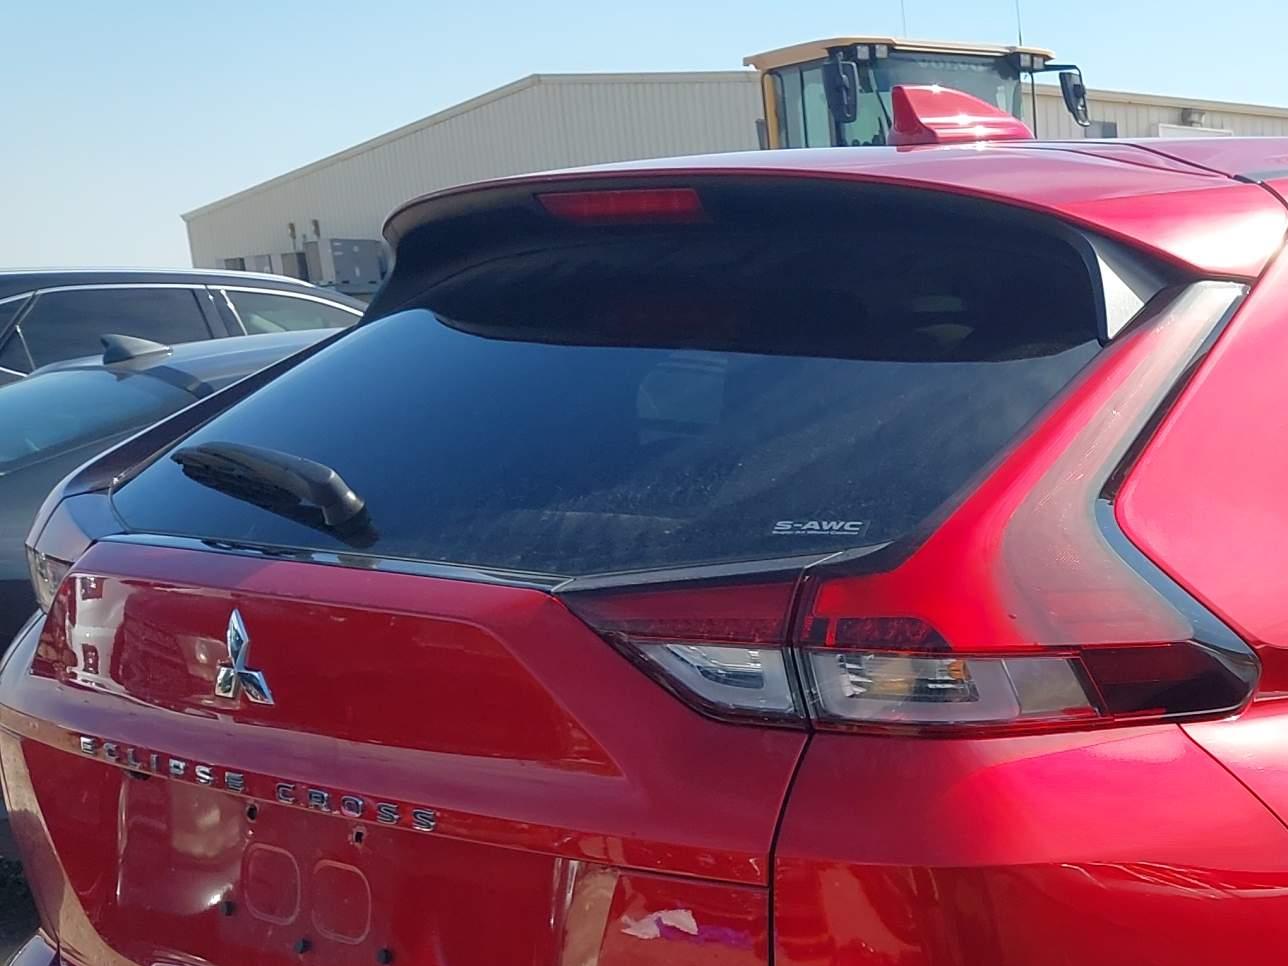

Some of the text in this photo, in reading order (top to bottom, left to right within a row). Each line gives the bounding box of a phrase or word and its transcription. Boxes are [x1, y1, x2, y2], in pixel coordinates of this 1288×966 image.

[773, 520, 864, 532] S-AWC
[79, 736, 438, 832] ECLIPSE CROSS
